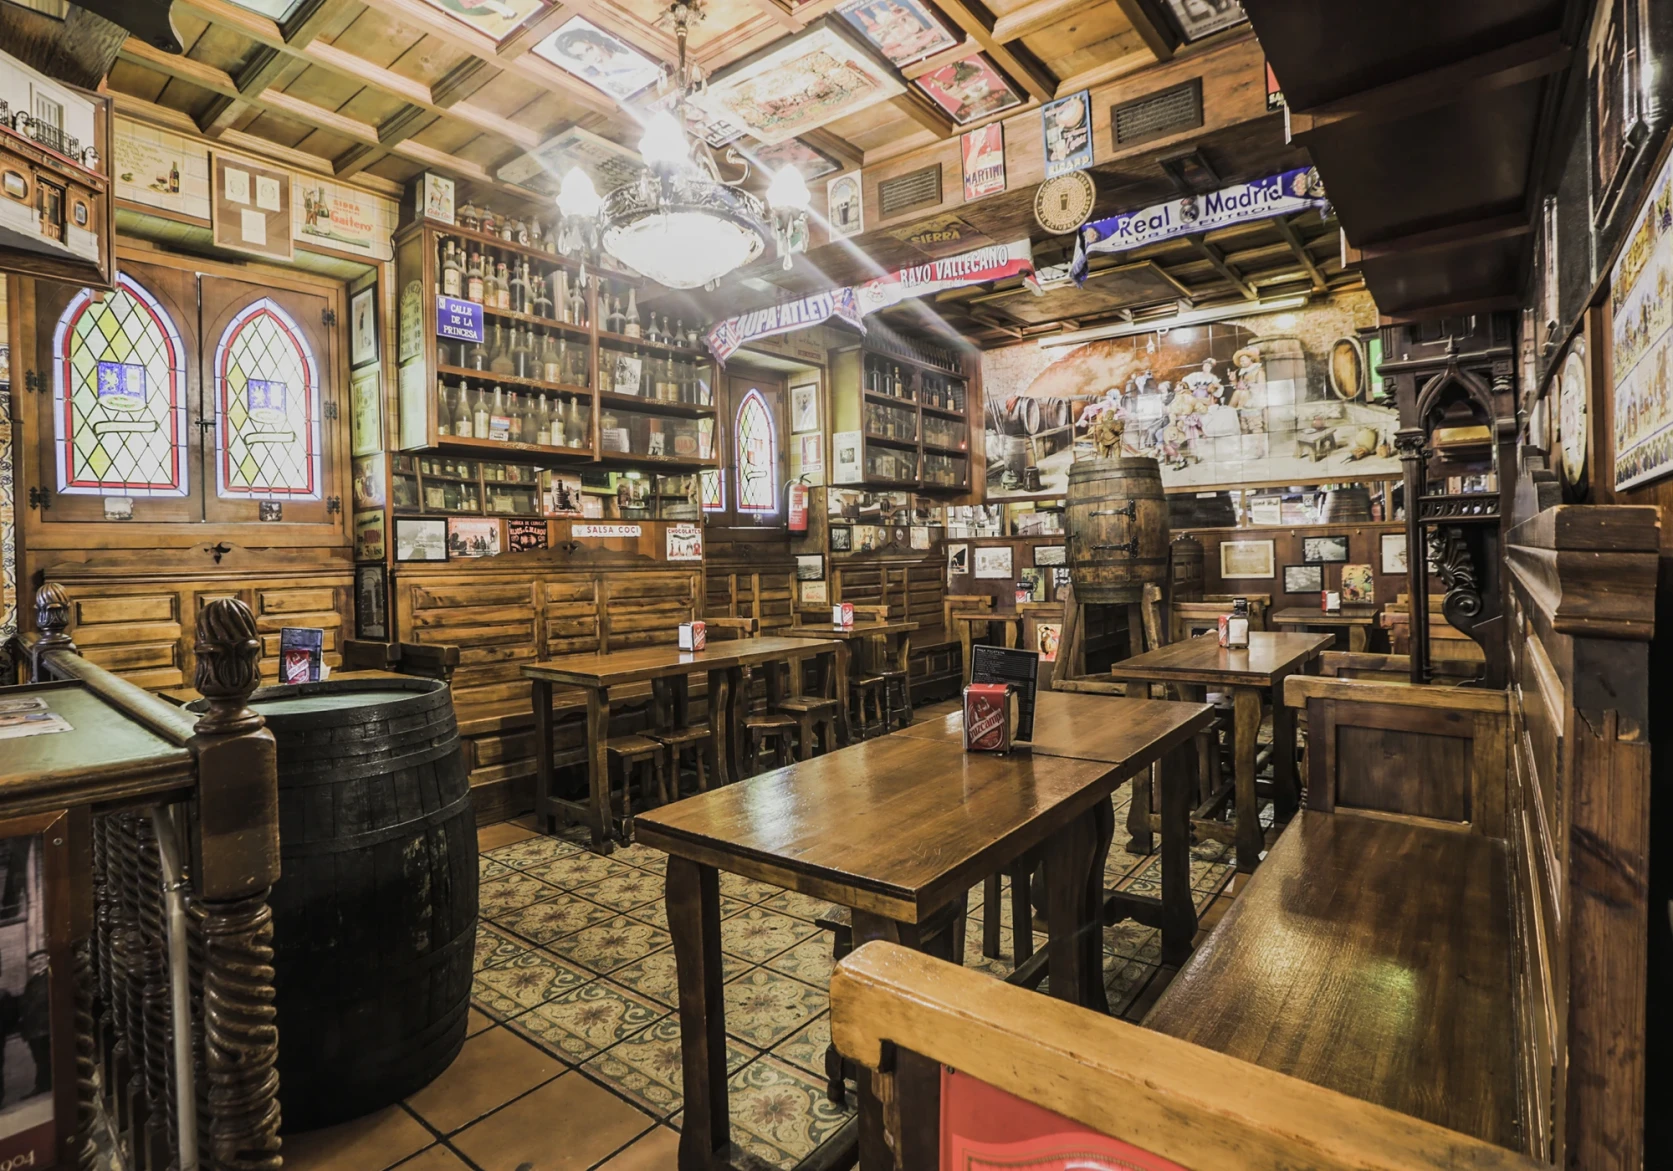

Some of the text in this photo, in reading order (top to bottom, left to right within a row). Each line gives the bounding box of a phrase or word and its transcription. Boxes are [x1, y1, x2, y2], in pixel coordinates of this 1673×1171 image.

[965, 164, 1003, 187] MARTINI
[333, 199, 360, 212] SIDRA
[1118, 176, 1282, 238] Real Madrid
[330, 210, 373, 231] Gaitero
[1111, 205, 1279, 247] CLUB DE FUTBOL
[911, 230, 961, 244] SIERRA
[900, 245, 1009, 288] RAYO VALLECANO
[450, 303, 473, 316] CALLE
[451, 315, 473, 327] DE LA
[443, 324, 478, 339] PRINCESA
[587, 526, 614, 534] SALSA
[969, 712, 1003, 739] ruzcamp
